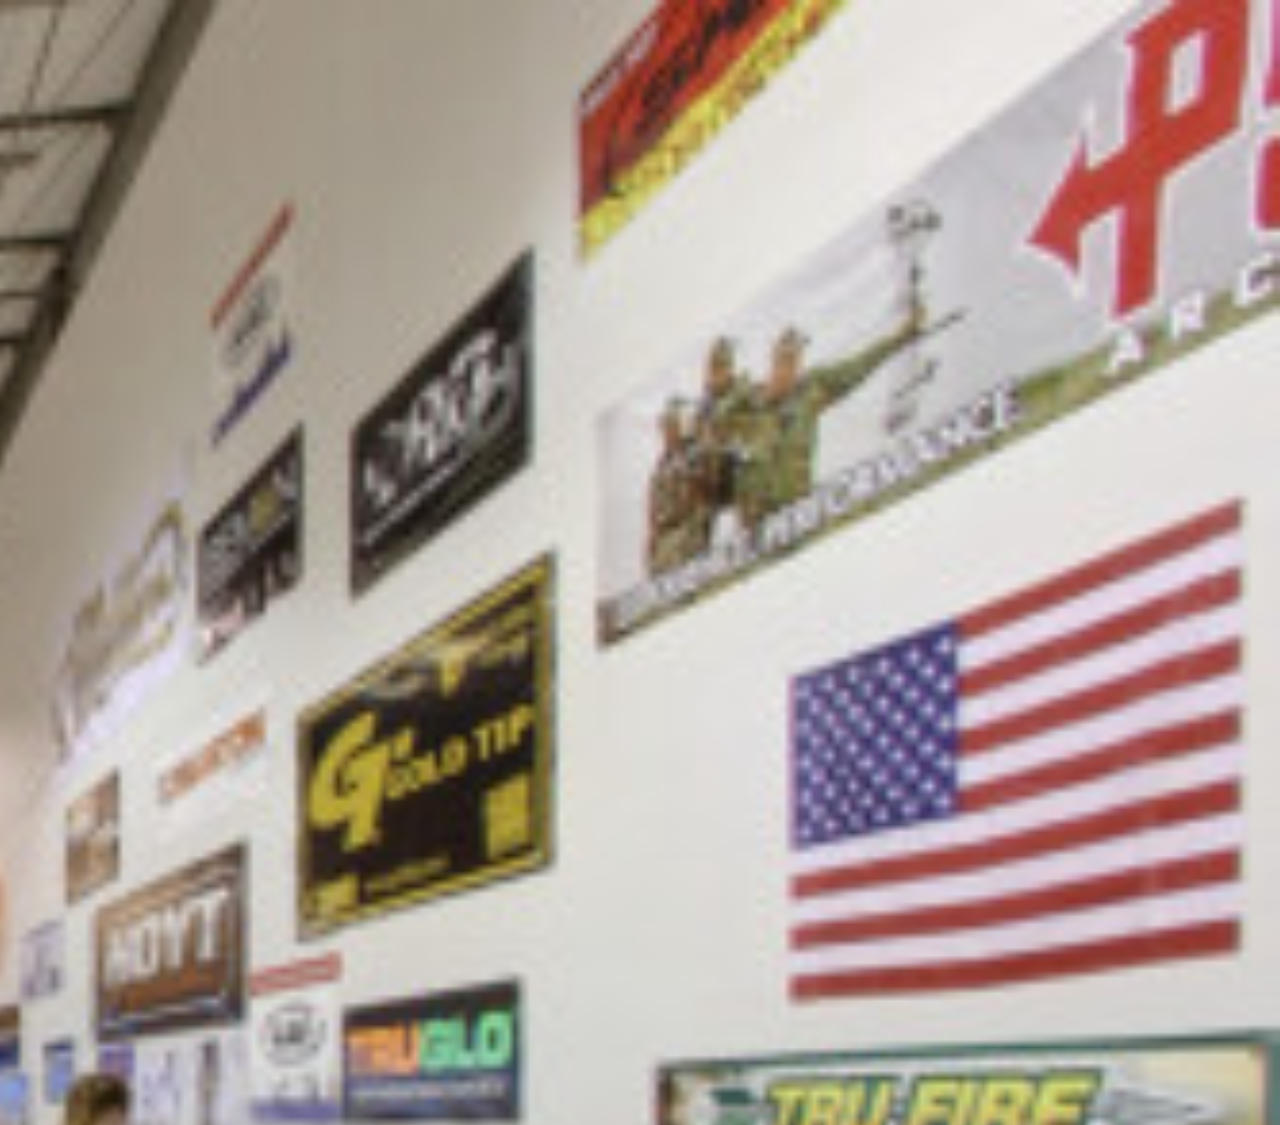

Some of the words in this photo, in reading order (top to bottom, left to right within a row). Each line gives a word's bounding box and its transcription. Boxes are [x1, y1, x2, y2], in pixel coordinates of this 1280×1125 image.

[472, 702, 534, 762] TIP
[102, 886, 234, 988] HOYT
[346, 1008, 515, 1078] TRUGLO
